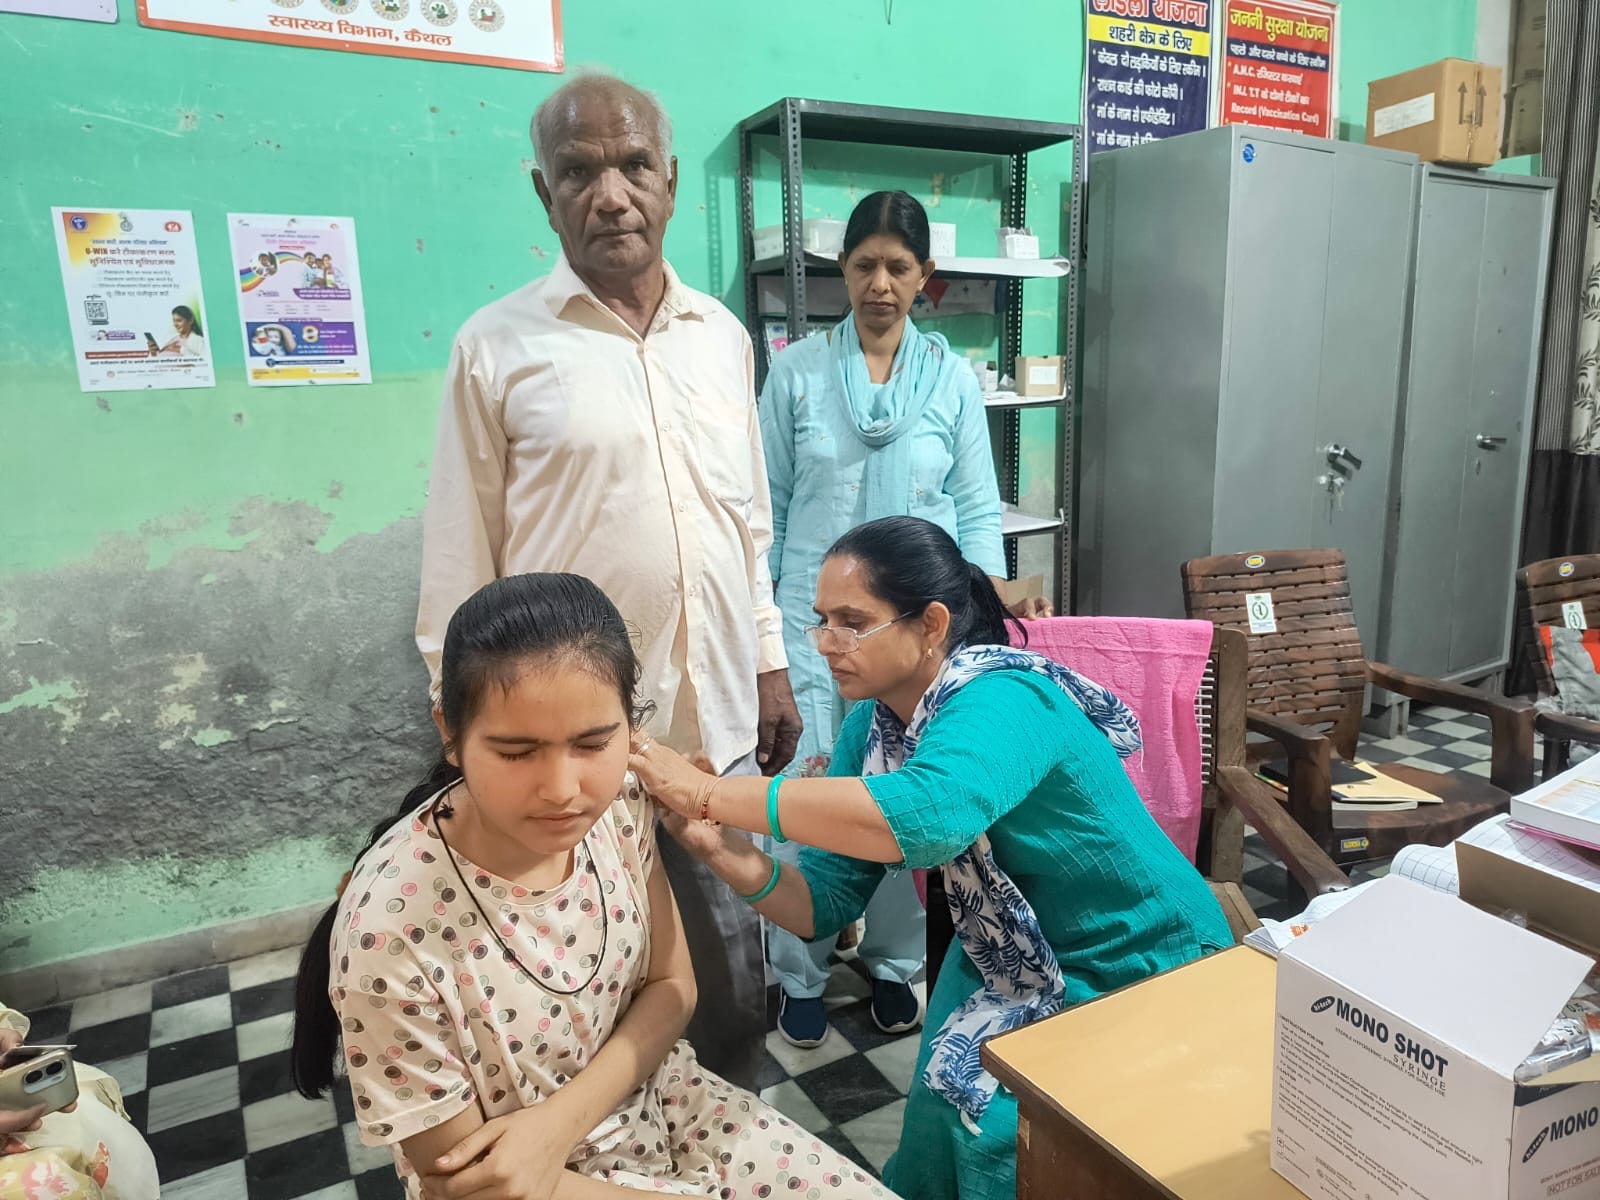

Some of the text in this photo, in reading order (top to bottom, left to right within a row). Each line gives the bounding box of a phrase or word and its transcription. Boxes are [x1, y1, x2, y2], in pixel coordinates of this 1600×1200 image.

[268, 14, 333, 34] स्वास्थ्य
[337, 19, 400, 42] विभाग,
[1109, 23, 1192, 51] शहरी क्षेत्र के लिए
[1230, 6, 1329, 42] जननी सुरक्षा योजना
[1159, 56, 1168, 72] के
[1168, 57, 1181, 76] लिए
[1107, 103, 1116, 119] के
[1231, 102, 1257, 116] Record
[1336, 998, 1389, 1043] MONO
[1394, 1032, 1449, 1078] SHOT
[1393, 1054, 1446, 1091] SYRINGE
[1550, 1106, 1599, 1142] MONO
